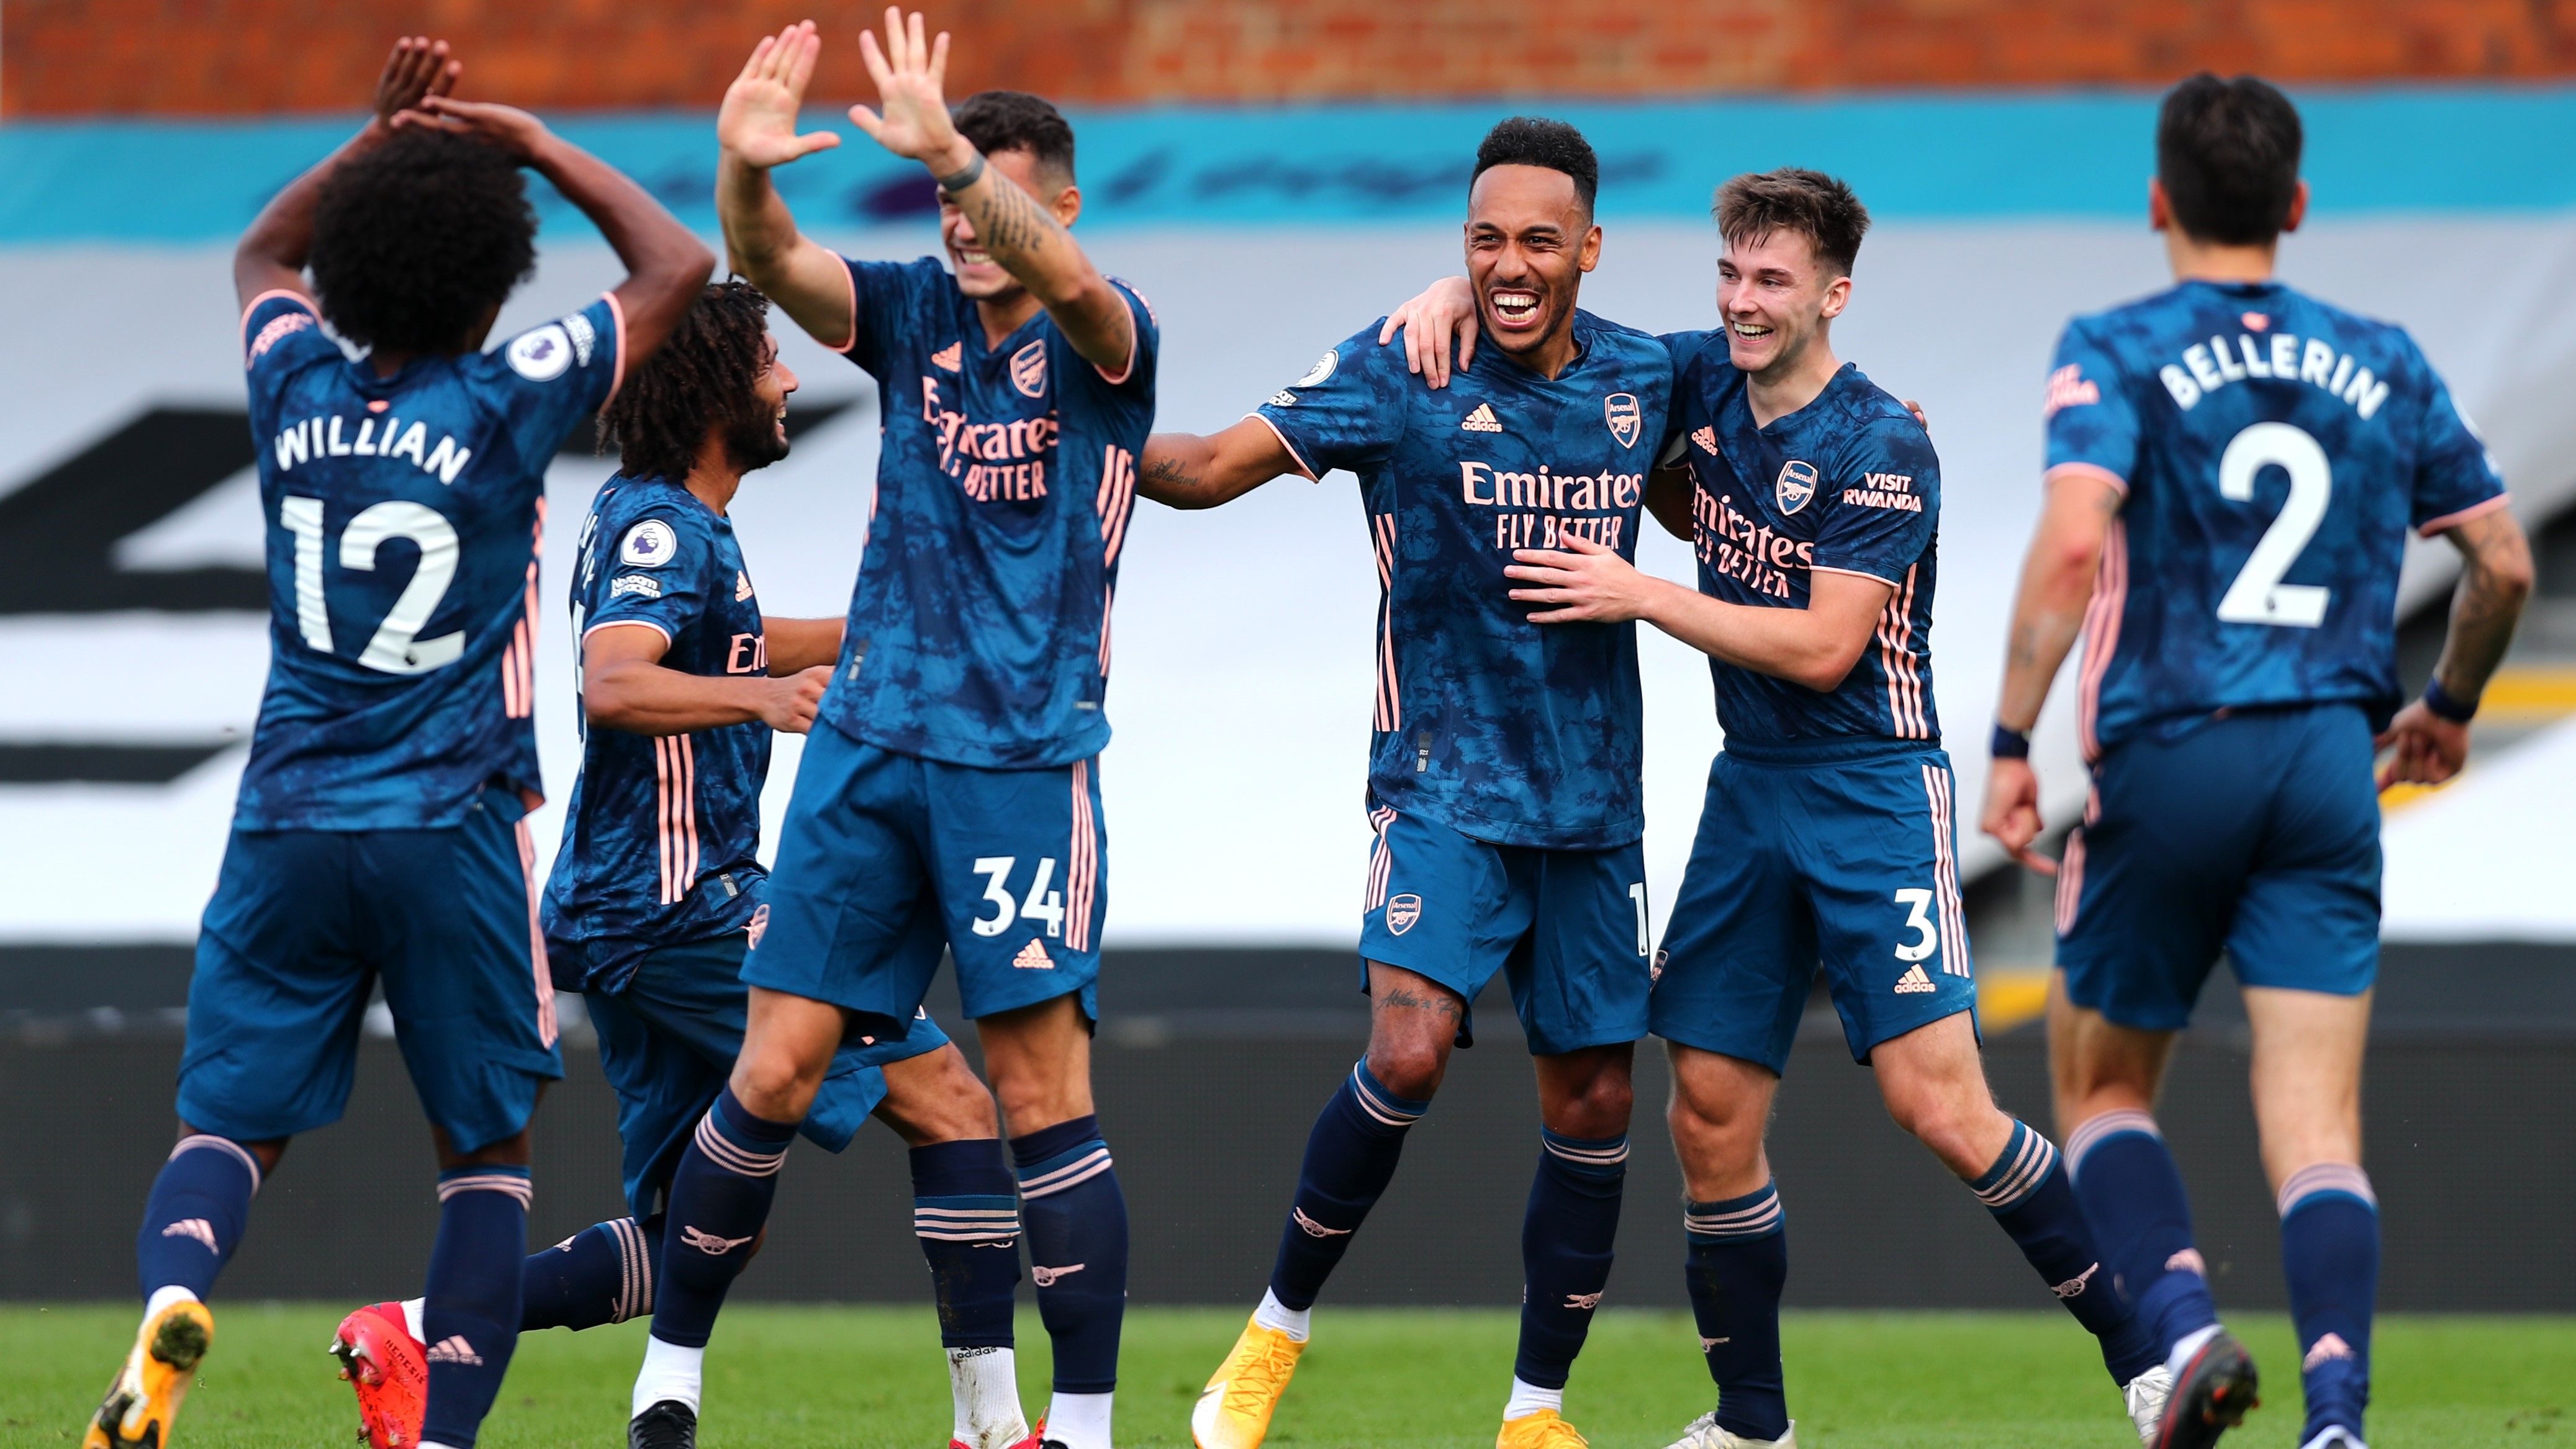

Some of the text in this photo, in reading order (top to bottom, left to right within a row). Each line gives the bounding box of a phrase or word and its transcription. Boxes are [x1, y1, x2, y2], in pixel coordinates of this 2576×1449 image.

[2159, 333, 2390, 421] BELLERIN
[922, 375, 1060, 461] Erates
[1461, 420, 1503, 433] adidas
[275, 415, 471, 486] WILLIAN
[1691, 431, 1718, 456] adidas
[964, 459, 1049, 502] BETTER
[1459, 461, 1643, 510] Emirates
[1787, 469, 1814, 484] Arsenal
[1864, 472, 1911, 492] VISIT
[1843, 489, 1922, 513] RWANDA
[1497, 514, 1535, 549] FLY
[1689, 478, 1814, 570] mirates
[2217, 421, 2332, 629] 2
[280, 495, 466, 675] 12
[1717, 543, 1789, 598] BETTER
[972, 856, 1065, 937] 34
[1894, 888, 1937, 961] 3
[1013, 957, 1055, 969] adidas
[1894, 981, 1936, 994] adidas
[385, 1339, 425, 1384] NEMESIS
[957, 1345, 997, 1358] adidas
